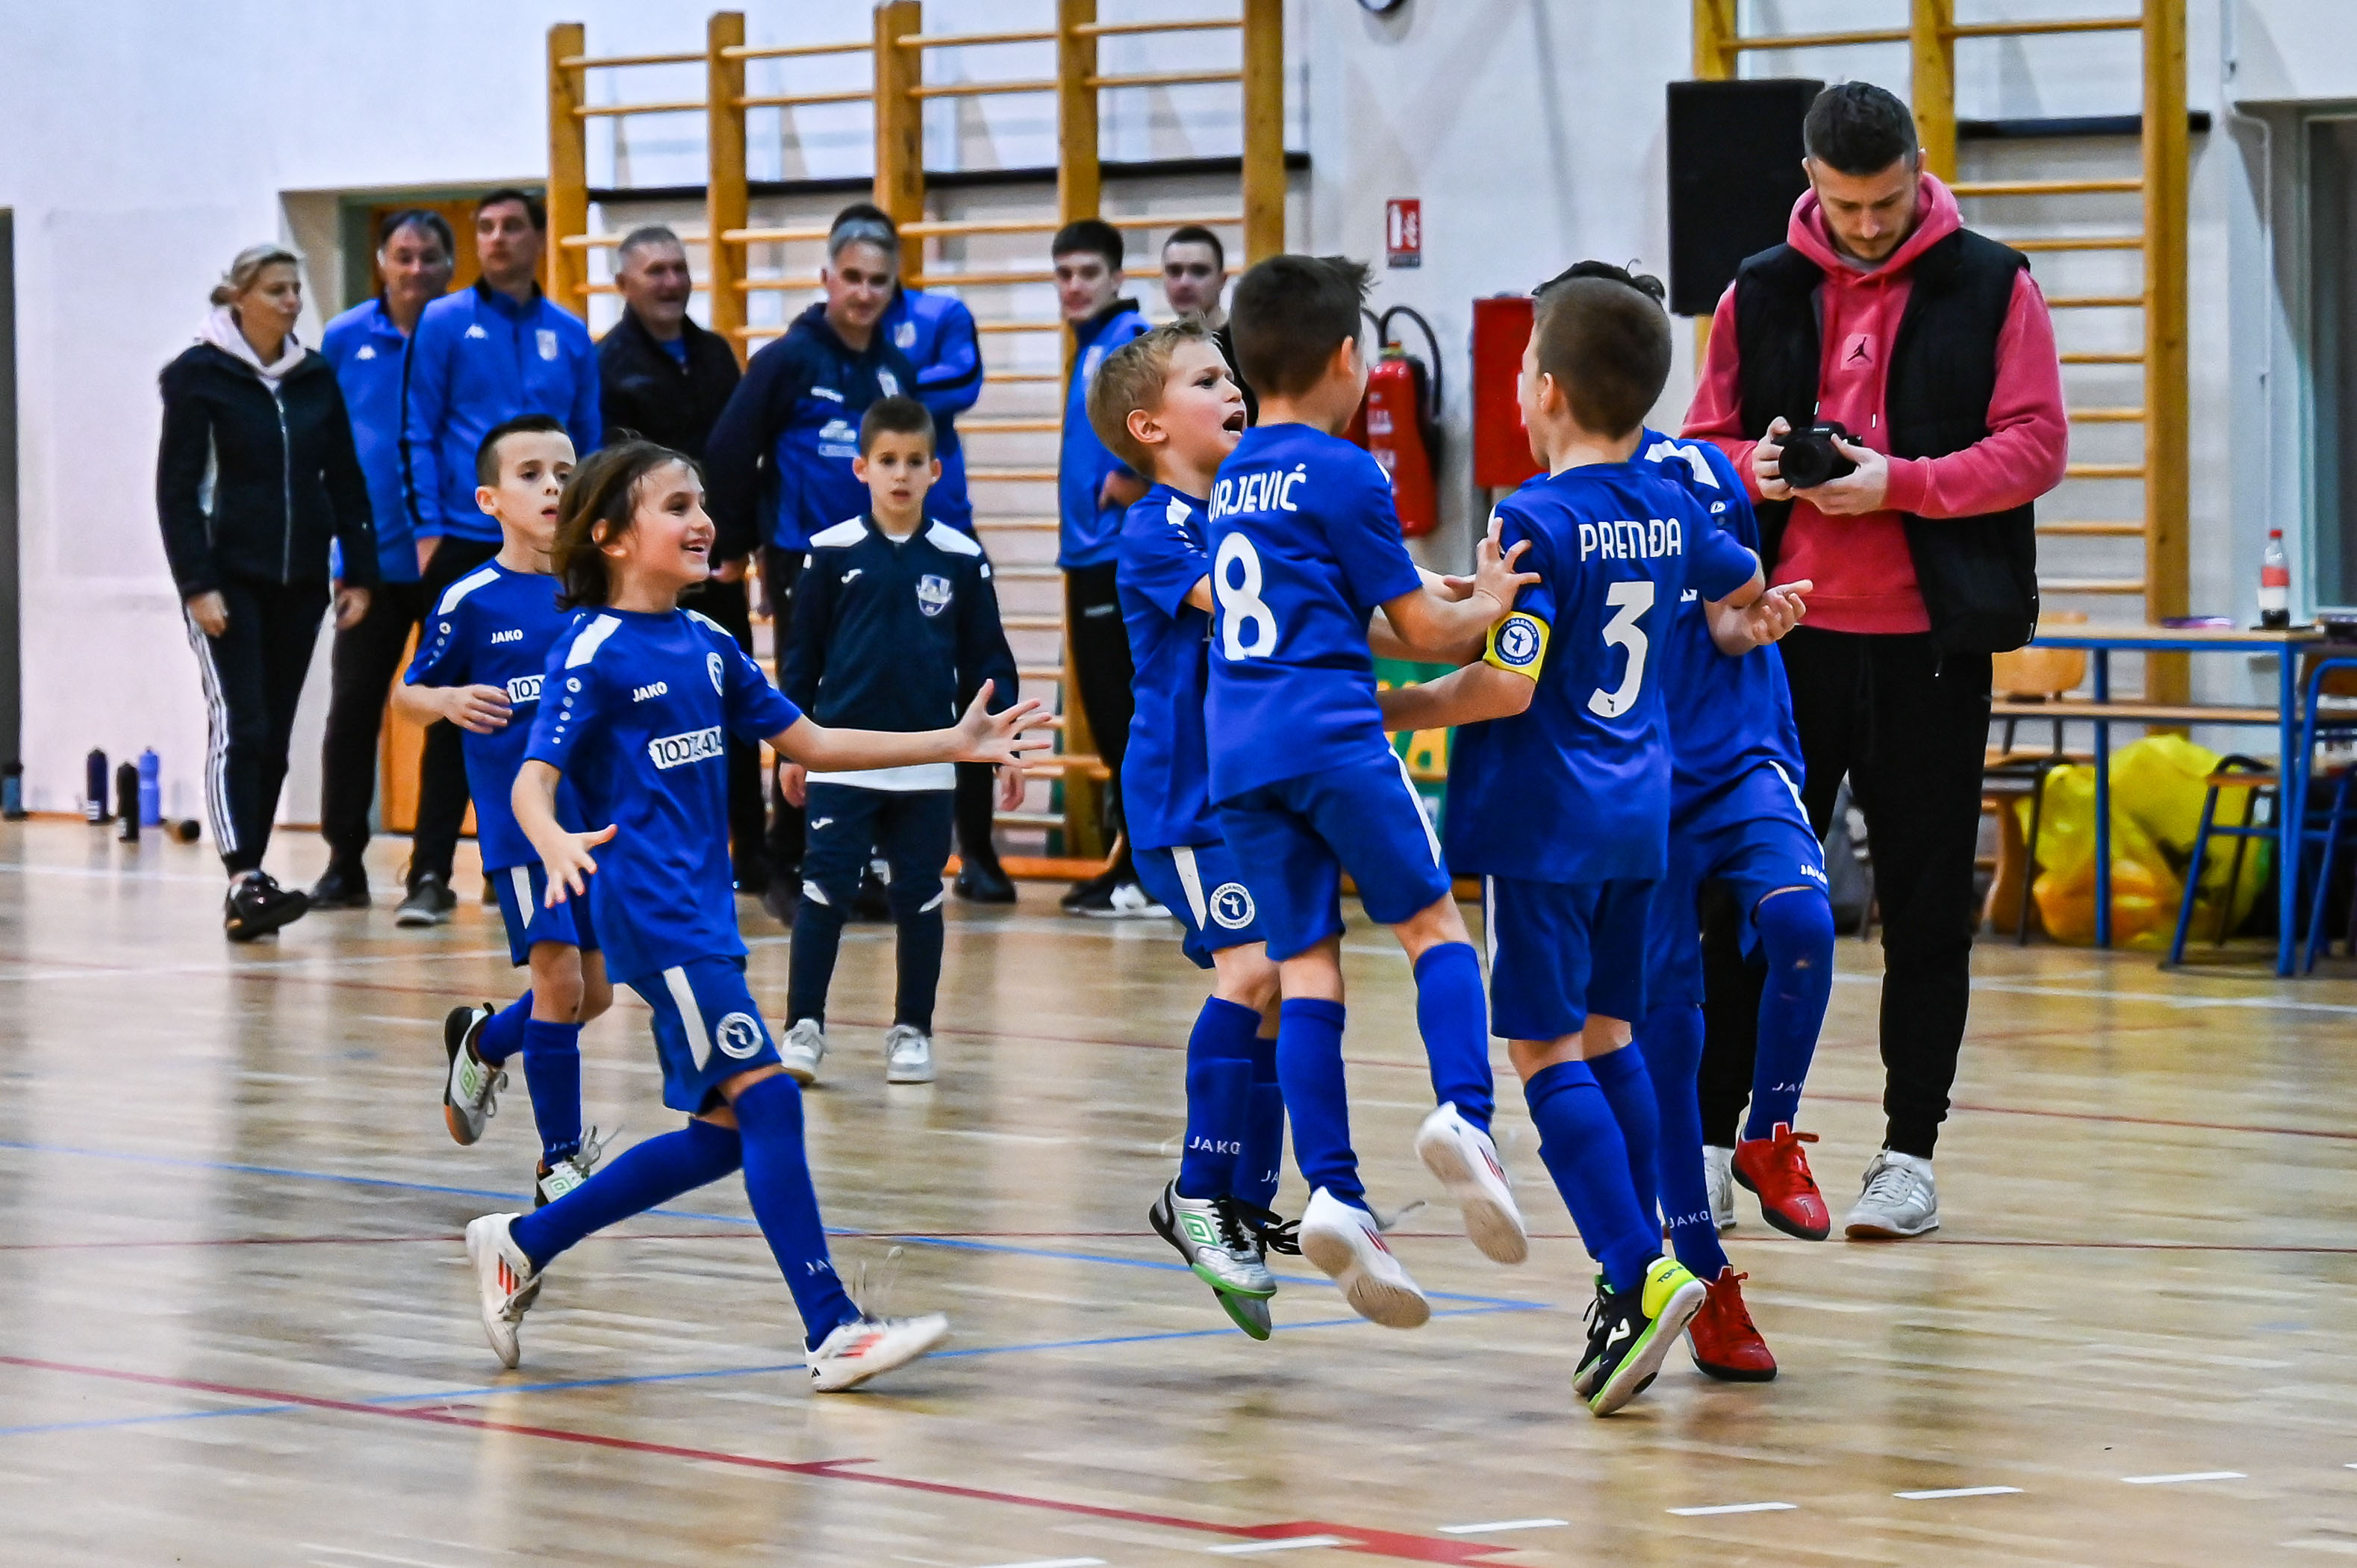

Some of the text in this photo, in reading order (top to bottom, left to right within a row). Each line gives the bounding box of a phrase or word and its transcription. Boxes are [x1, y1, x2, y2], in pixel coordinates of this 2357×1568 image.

[1214, 532, 1278, 662] 8
[491, 629, 523, 644] JAKO
[1587, 581, 1655, 718] 3
[632, 681, 668, 703] JAKO
[1801, 864, 1828, 885] JAKO
[1189, 1136, 1241, 1154] JAKO
[1260, 1169, 1279, 1183] JA
[1669, 1210, 1710, 1229] JAKO
